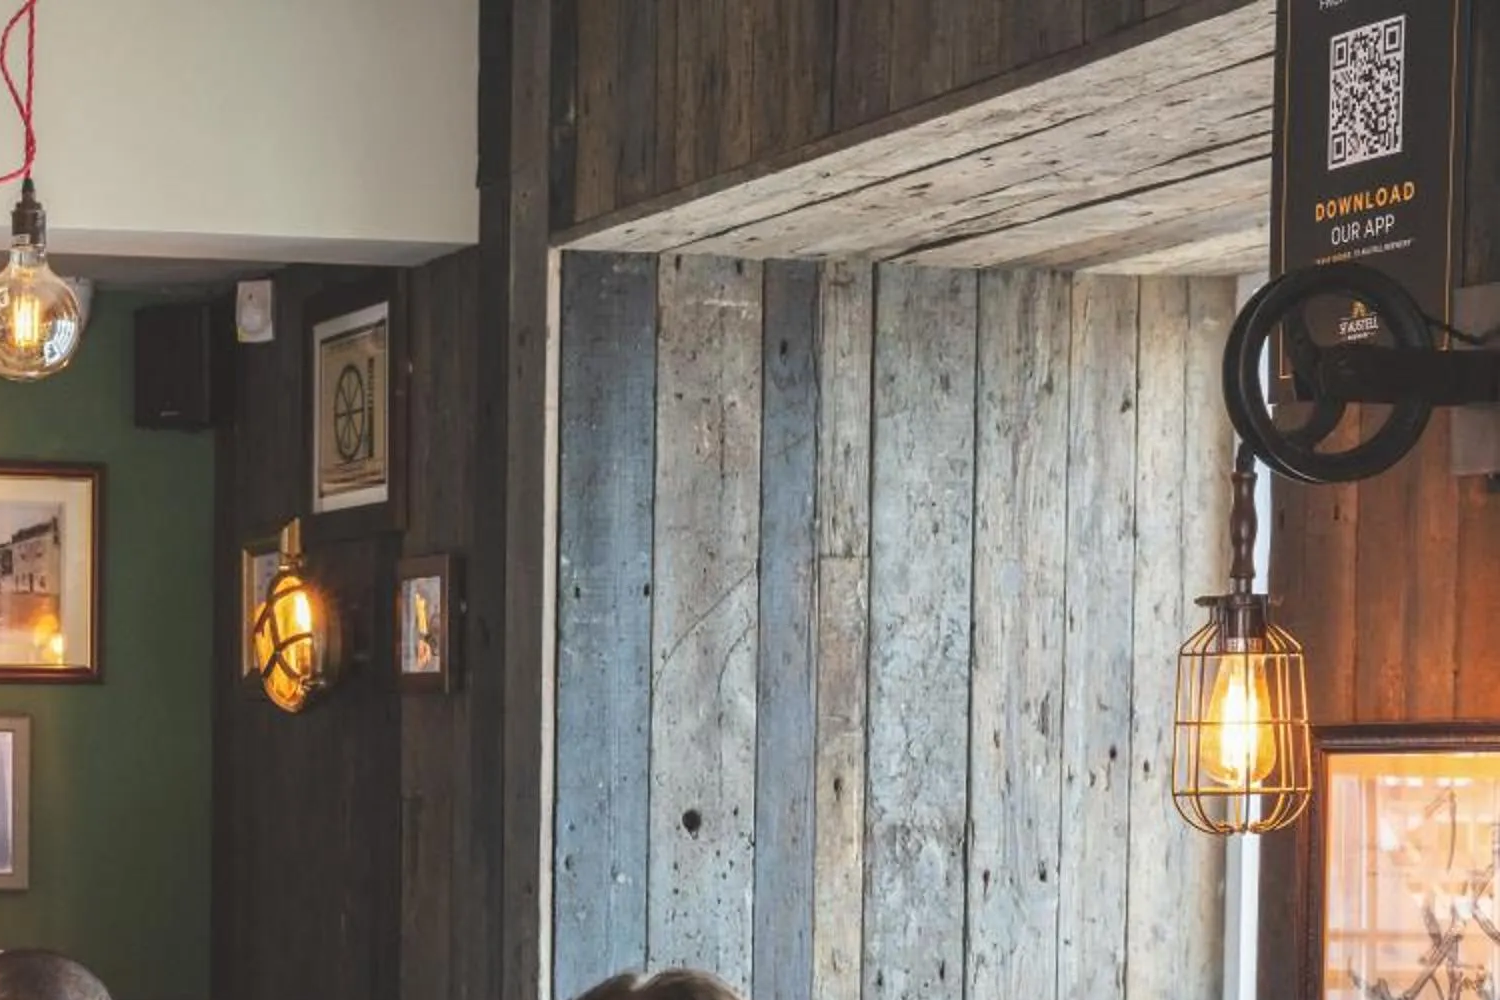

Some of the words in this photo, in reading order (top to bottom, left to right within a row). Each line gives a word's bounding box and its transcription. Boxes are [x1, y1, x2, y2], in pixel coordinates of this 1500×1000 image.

[1315, 181, 1415, 222] DOWNLOAD
[1331, 221, 1361, 246] OUR
[1364, 213, 1396, 239] APP
